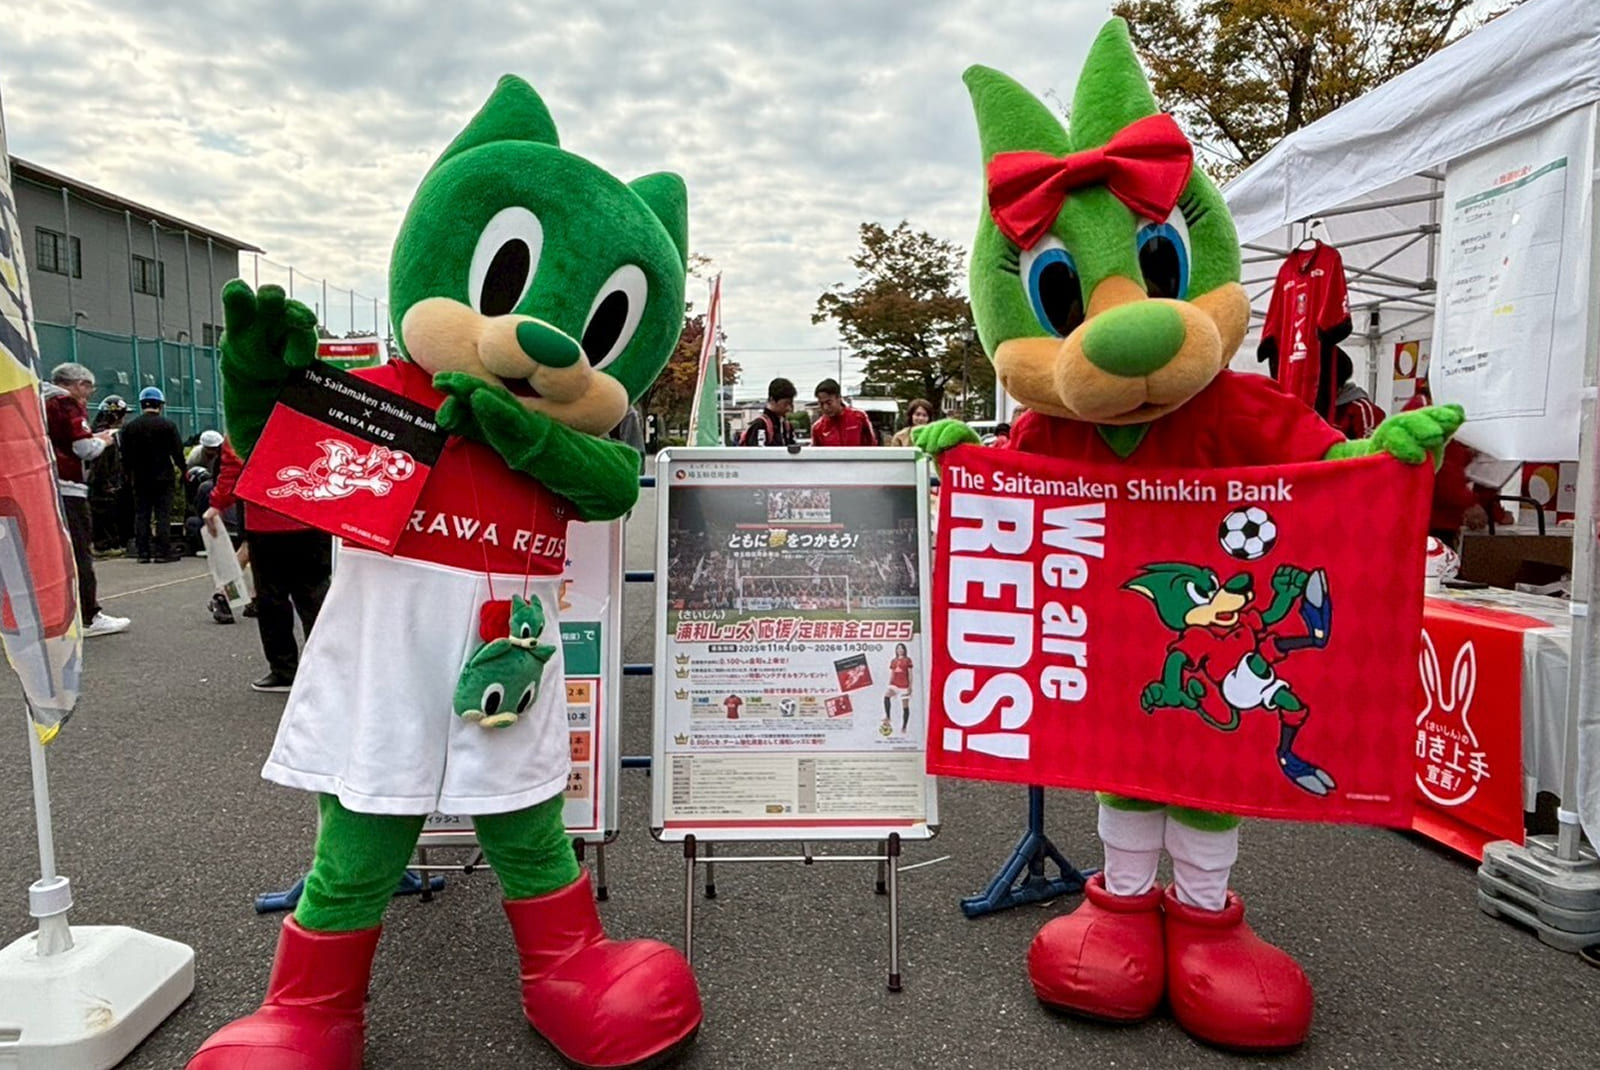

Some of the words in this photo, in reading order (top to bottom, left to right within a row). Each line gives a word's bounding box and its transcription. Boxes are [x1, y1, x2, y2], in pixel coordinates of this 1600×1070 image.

[305, 370, 322, 384] The
[323, 378, 378, 408] Saitamaken
[380, 401, 413, 423] Shinkin
[414, 416, 437, 432] Bank
[328, 408, 365, 429] URAWA
[367, 424, 396, 441] REDS
[949, 467, 985, 490] The
[992, 471, 1118, 499] Saitamaken
[1127, 480, 1216, 502] Shinkin
[1228, 478, 1293, 502] Bank
[405, 509, 499, 546] RAWA
[512, 529, 565, 558] REDS
[1042, 502, 1106, 589] We
[943, 492, 1035, 760] REDS!
[1040, 601, 1088, 702] are
